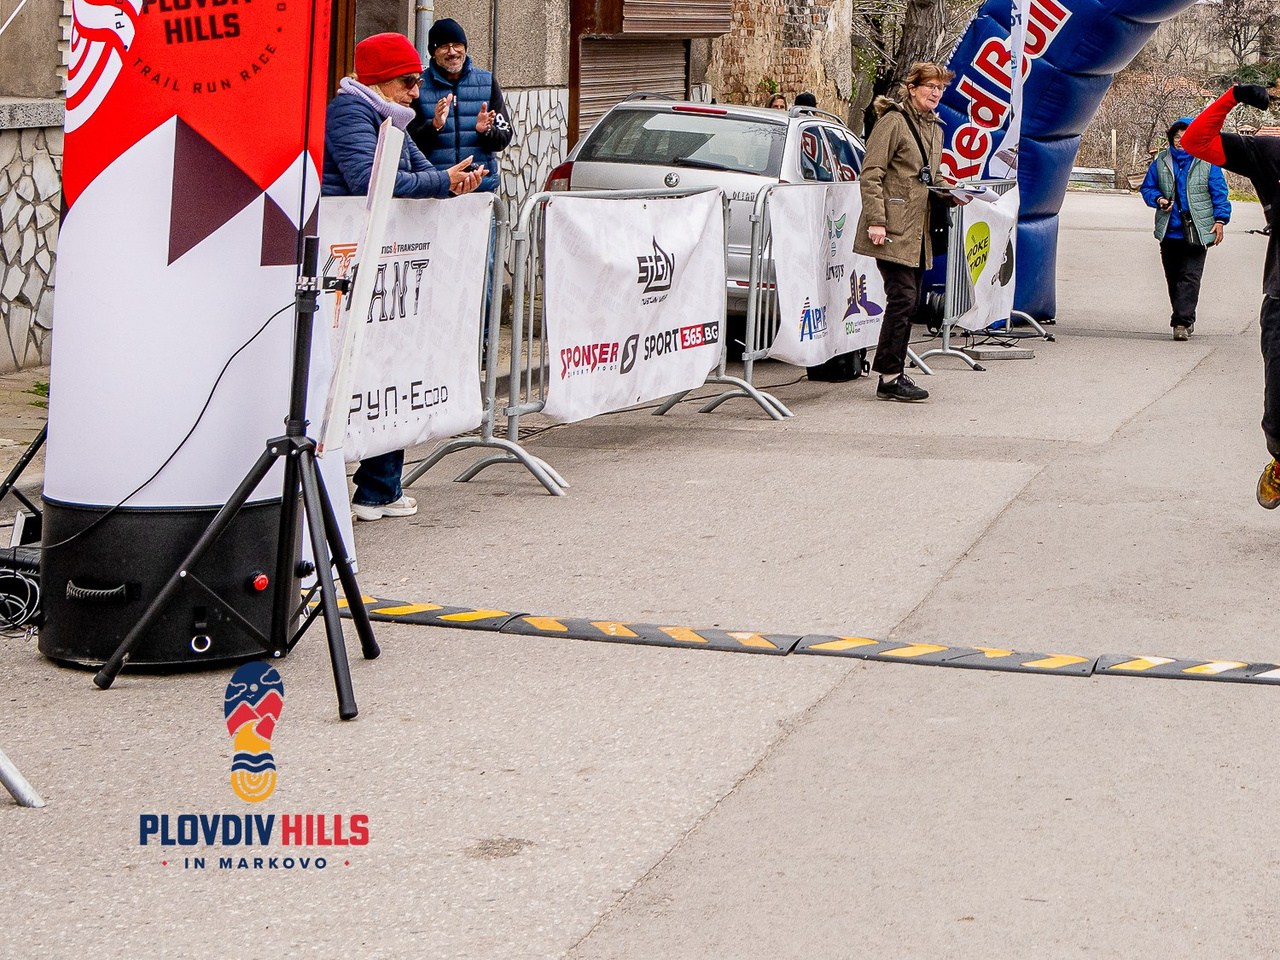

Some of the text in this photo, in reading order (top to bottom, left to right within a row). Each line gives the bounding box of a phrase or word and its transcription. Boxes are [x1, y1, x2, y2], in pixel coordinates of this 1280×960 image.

[164, 12, 241, 45] HILLS
[132, 43, 277, 93] TRAIL RUN RACE
[941, 74, 1012, 186] Red
[560, 342, 619, 380] SPONSER
